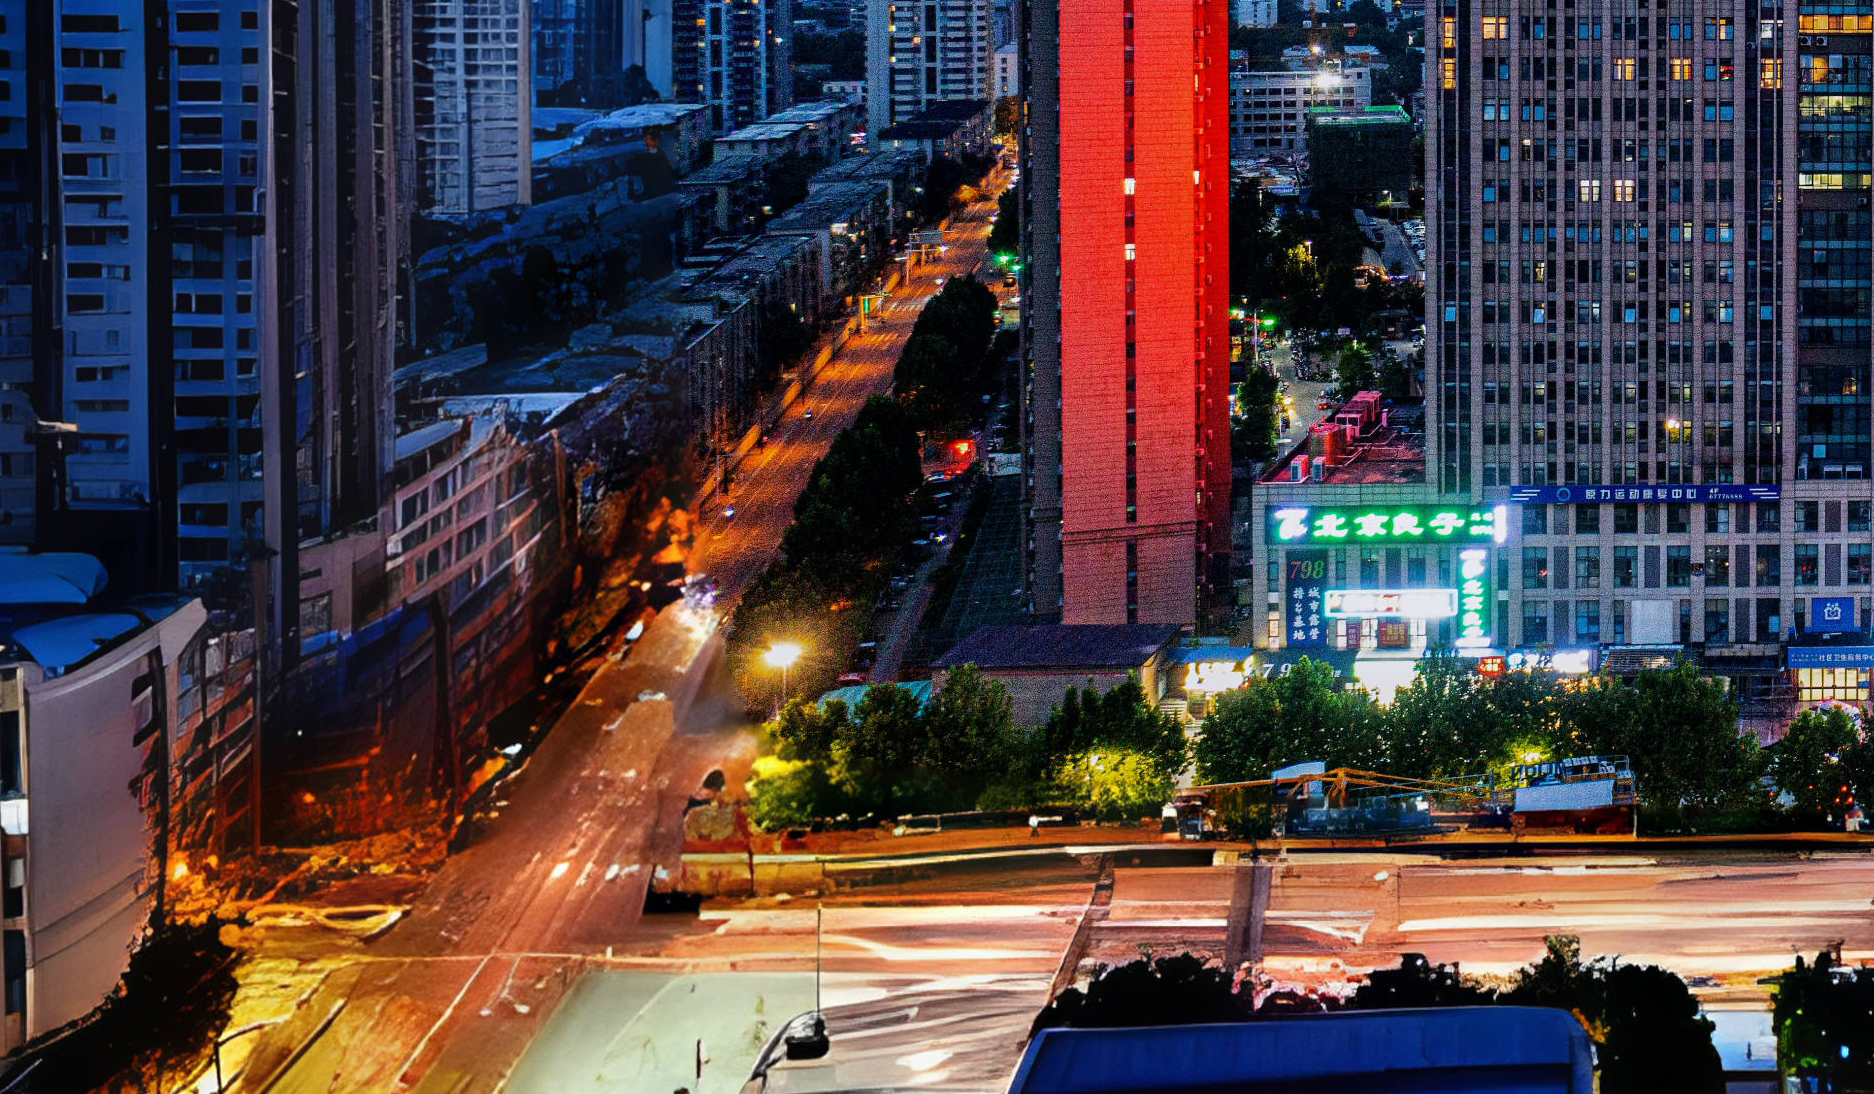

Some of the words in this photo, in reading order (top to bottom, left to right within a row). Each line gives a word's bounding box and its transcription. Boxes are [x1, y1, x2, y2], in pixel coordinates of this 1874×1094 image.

[1585, 488, 1697, 500] 原力运动康复中心
[1313, 512, 1465, 538] 北京良子
[1290, 560, 1325, 579] 798
[1308, 586, 1321, 640] 城市露营
